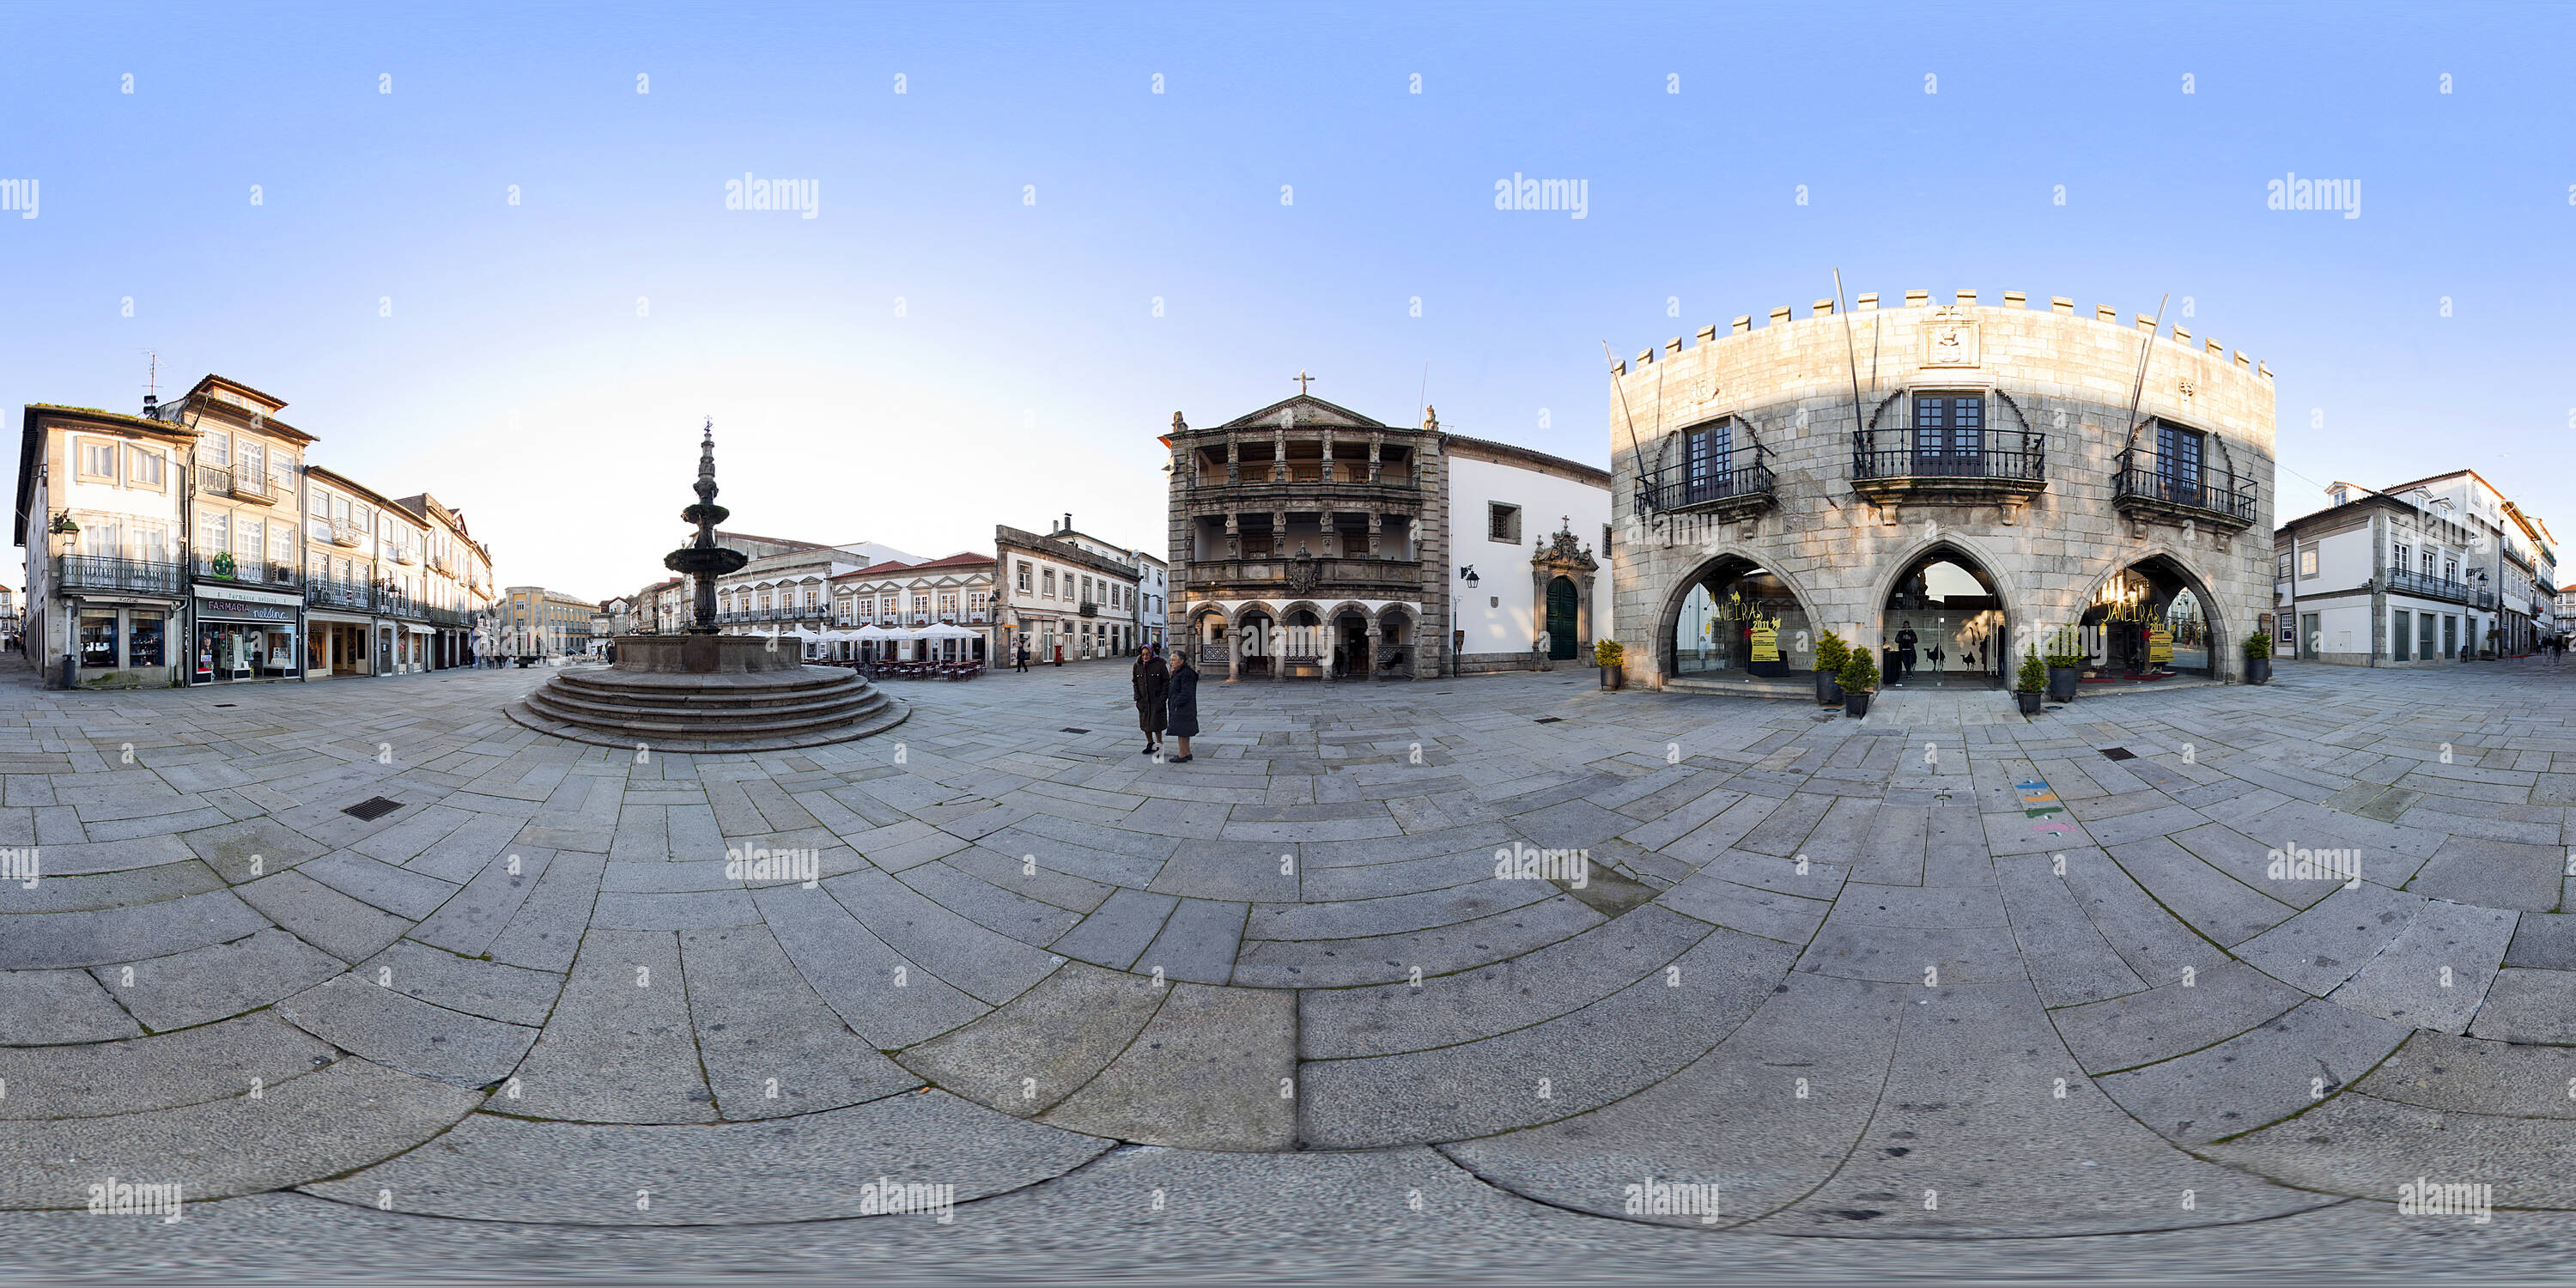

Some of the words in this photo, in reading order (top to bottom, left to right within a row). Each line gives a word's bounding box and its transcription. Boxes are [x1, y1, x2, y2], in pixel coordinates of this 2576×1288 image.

[2101, 602, 2160, 623] JANEIRAS
[1753, 620, 1770, 629] 2011
[2149, 623, 2165, 632] 2011
